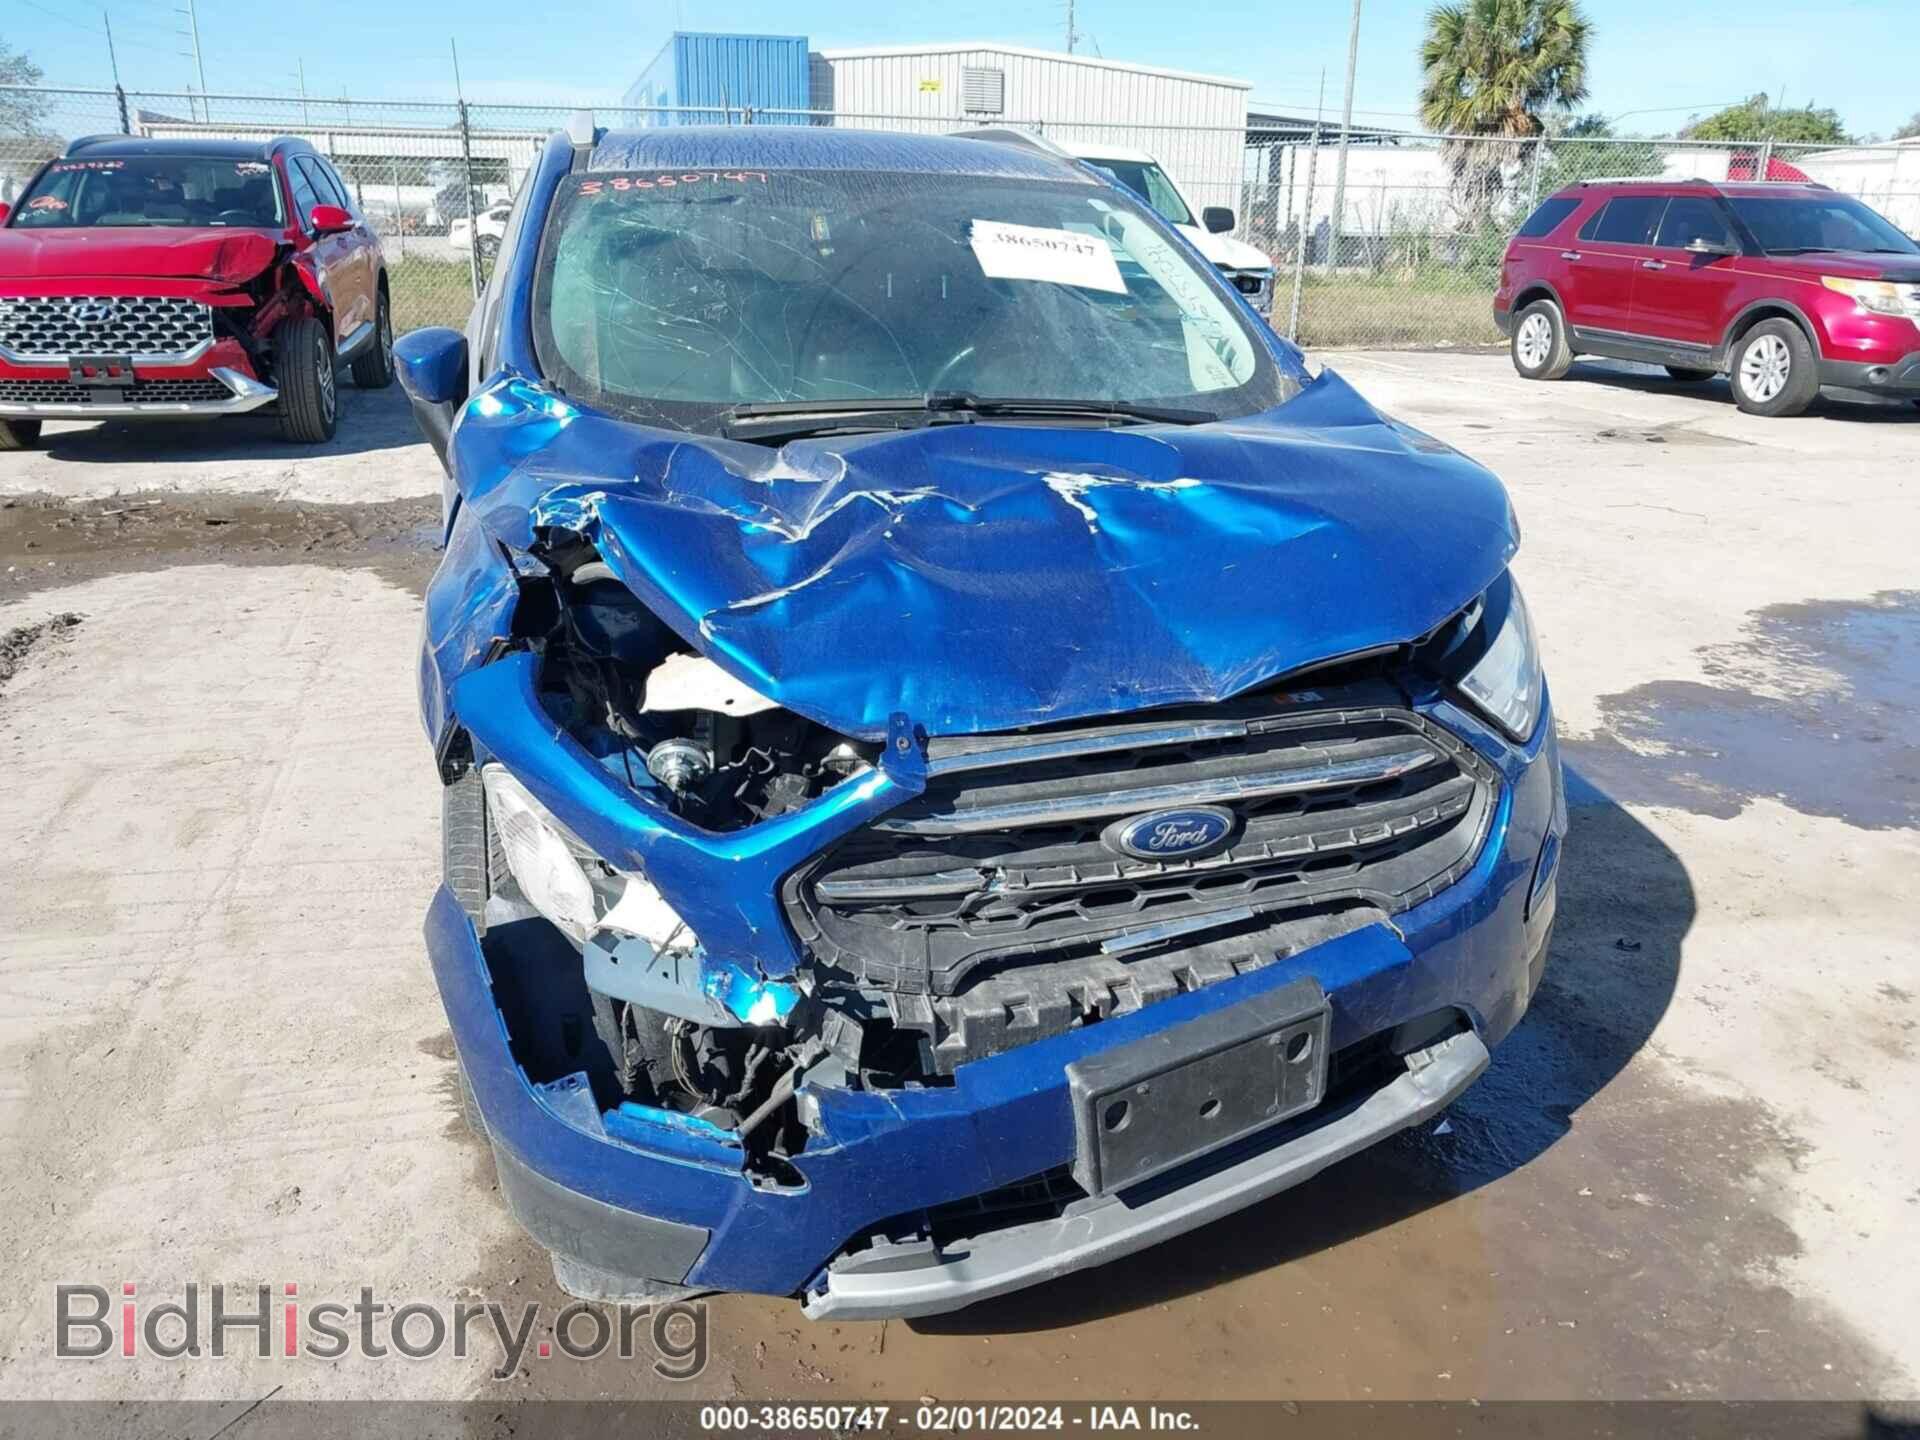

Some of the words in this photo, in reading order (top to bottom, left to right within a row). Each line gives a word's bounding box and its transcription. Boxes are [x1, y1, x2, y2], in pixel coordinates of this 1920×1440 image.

[579, 171, 768, 195] 38650747
[992, 231, 1095, 256] 38650747
[1149, 820, 1208, 849] Ford
